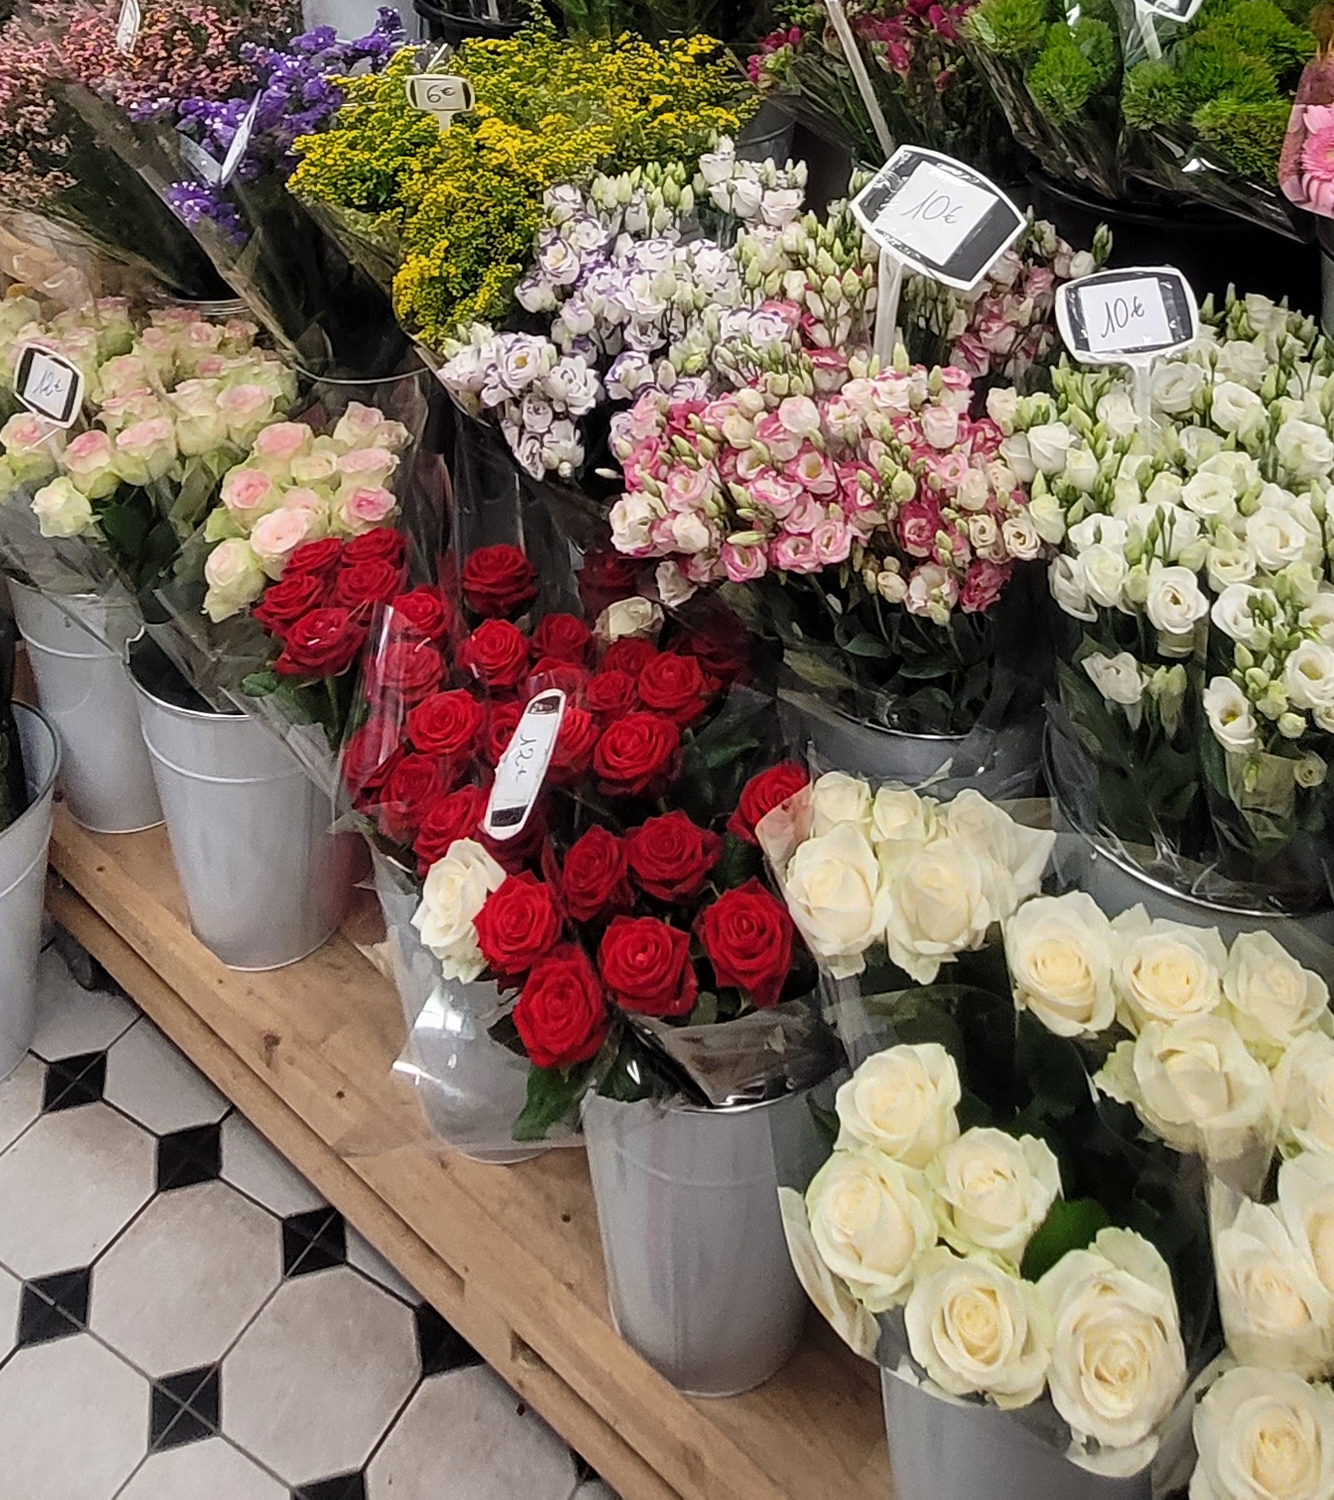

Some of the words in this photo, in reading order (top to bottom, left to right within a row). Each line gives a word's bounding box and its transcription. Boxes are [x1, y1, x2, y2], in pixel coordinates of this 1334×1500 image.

[426, 84, 456, 104] 6€
[900, 189, 963, 225] 10€
[1100, 295, 1145, 338] 10€
